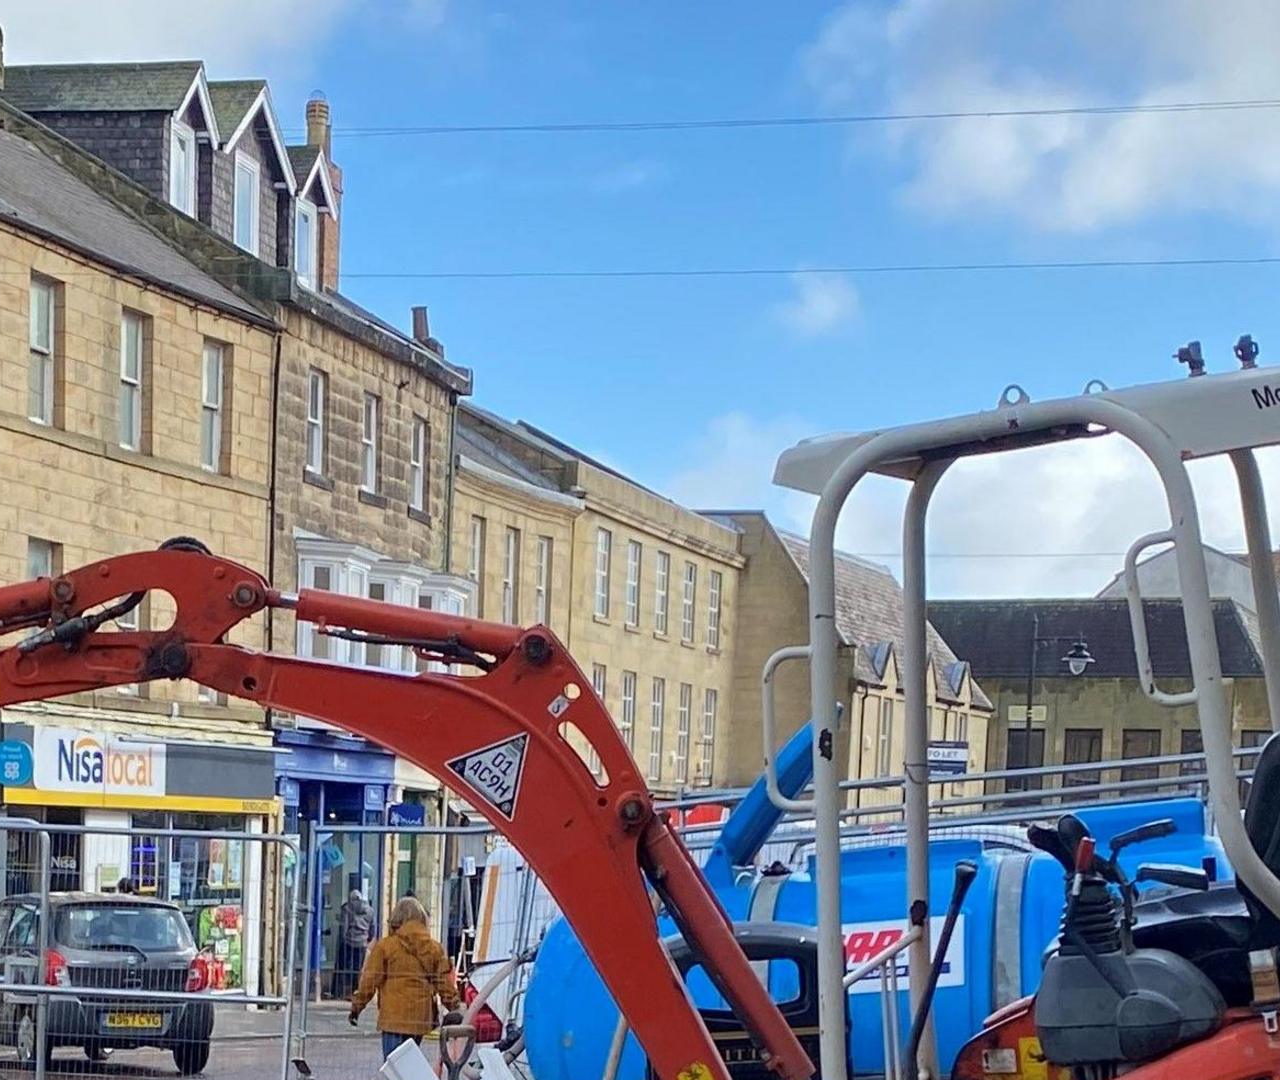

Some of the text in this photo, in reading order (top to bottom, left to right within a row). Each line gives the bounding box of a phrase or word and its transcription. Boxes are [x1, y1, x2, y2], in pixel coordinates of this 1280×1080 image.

[469, 760, 510, 798] AC9H
[50, 856, 77, 869] Nisa
[843, 929, 904, 964] AP
